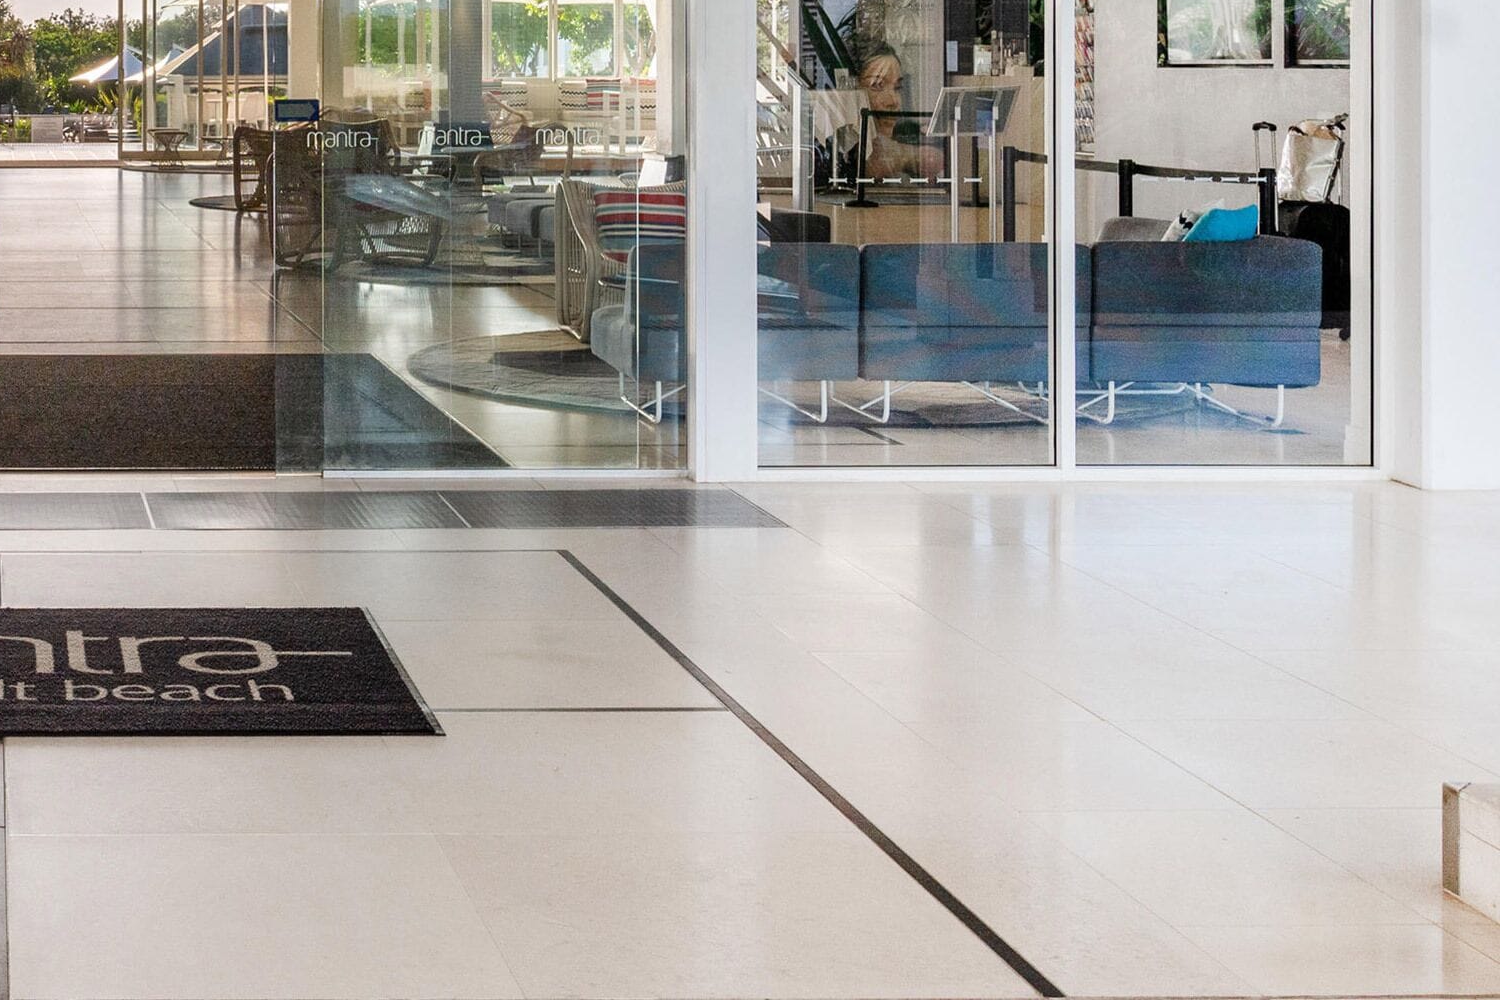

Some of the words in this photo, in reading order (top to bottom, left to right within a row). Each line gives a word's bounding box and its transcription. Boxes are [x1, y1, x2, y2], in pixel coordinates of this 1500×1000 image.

[306, 128, 379, 149] mantra
[535, 125, 601, 146] mantra
[64, 679, 294, 701] beach
